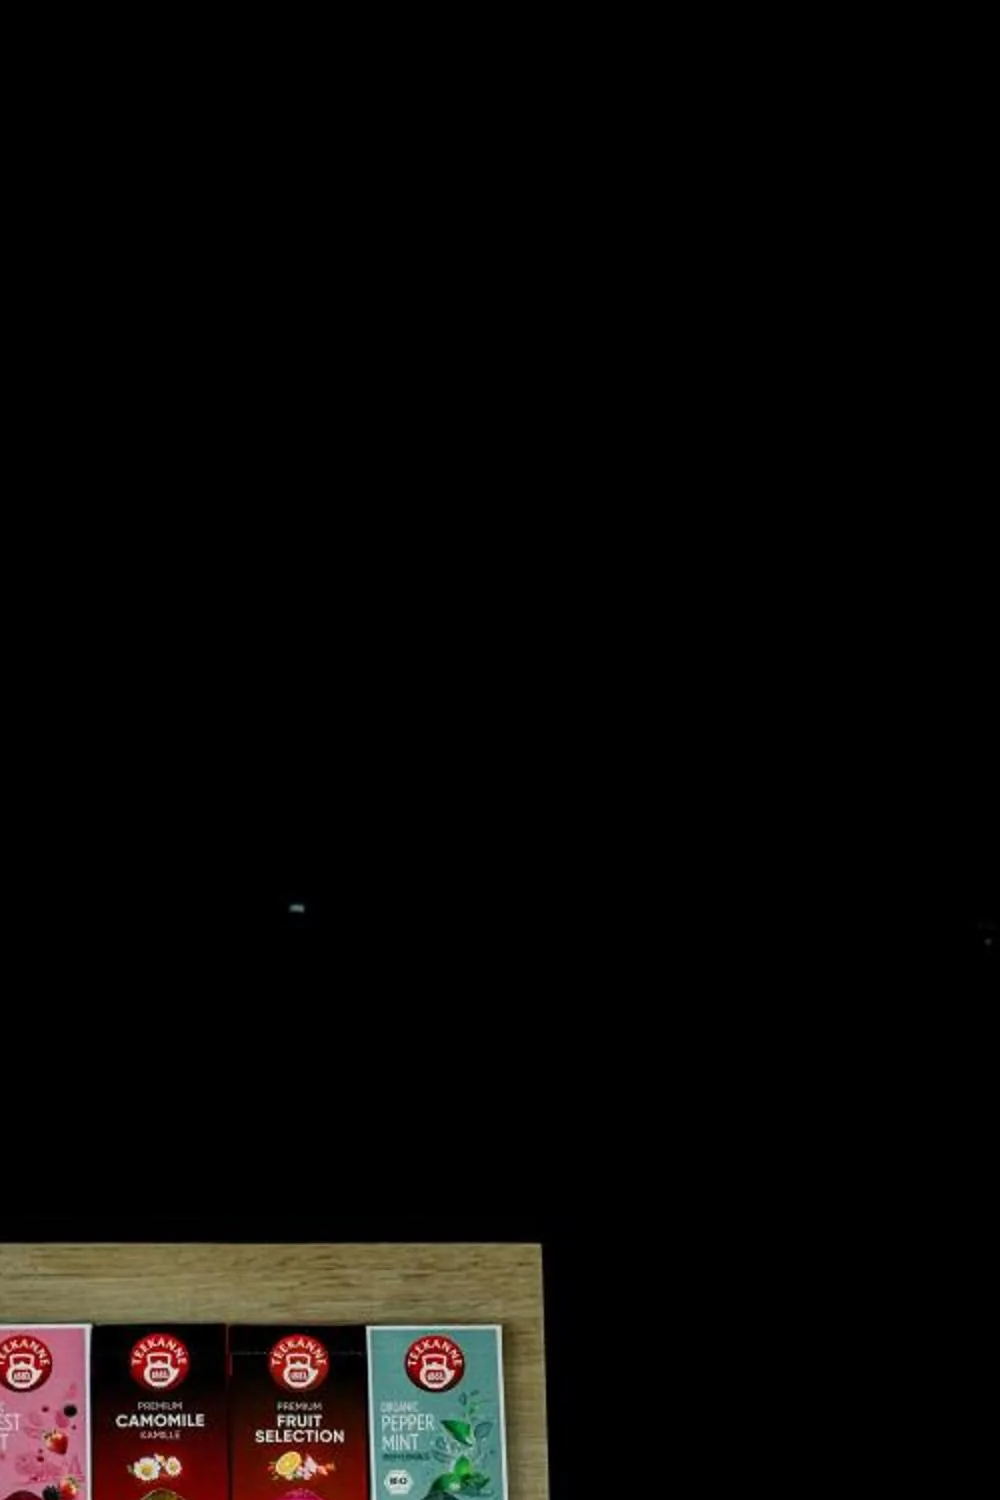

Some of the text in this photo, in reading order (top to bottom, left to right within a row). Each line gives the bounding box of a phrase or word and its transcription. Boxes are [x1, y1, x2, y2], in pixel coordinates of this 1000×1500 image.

[131, 1334, 188, 1366] TEEKANNE
[271, 1335, 328, 1367] TEEKANNE
[407, 1336, 463, 1368] TEEKANNE
[137, 1401, 183, 1411] PREMIUM
[277, 1401, 323, 1411] PREMIUM
[115, 1413, 205, 1428] CAMOMILE
[277, 1414, 323, 1428] FRUIT
[381, 1413, 435, 1431] PEPPER
[255, 1429, 345, 1444] SELECTION
[382, 1433, 420, 1451] MINT
